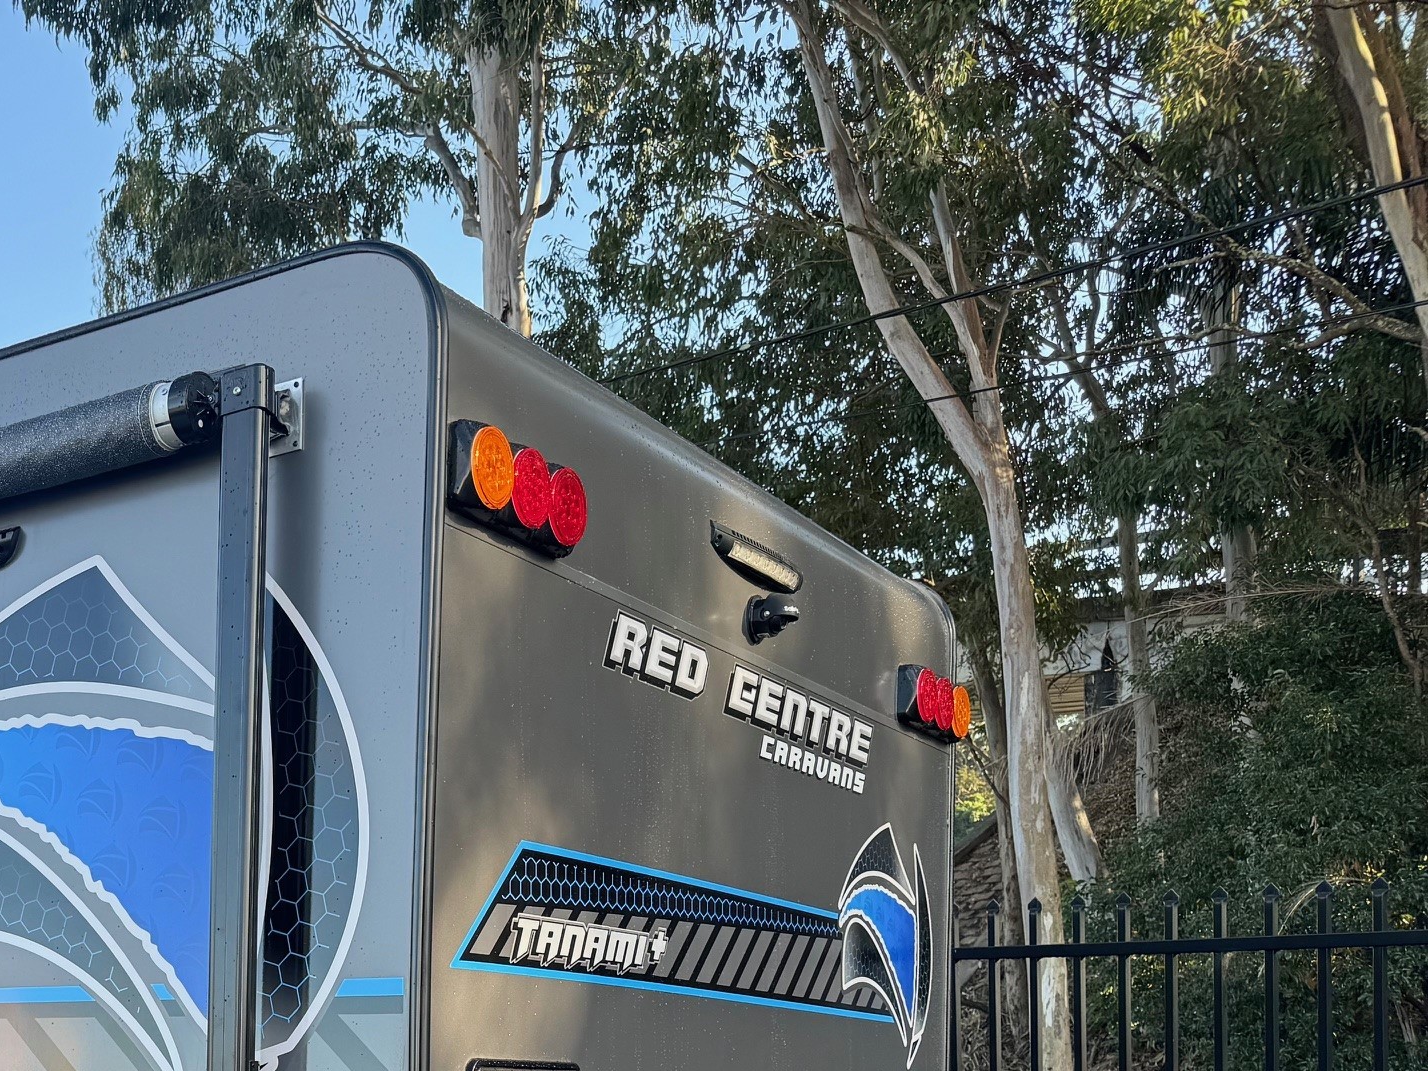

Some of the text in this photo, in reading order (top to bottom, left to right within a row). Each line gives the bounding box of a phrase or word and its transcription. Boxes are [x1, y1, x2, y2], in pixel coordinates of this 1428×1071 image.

[603, 610, 874, 767] RED CENTRE
[759, 734, 866, 794] CARAVANS
